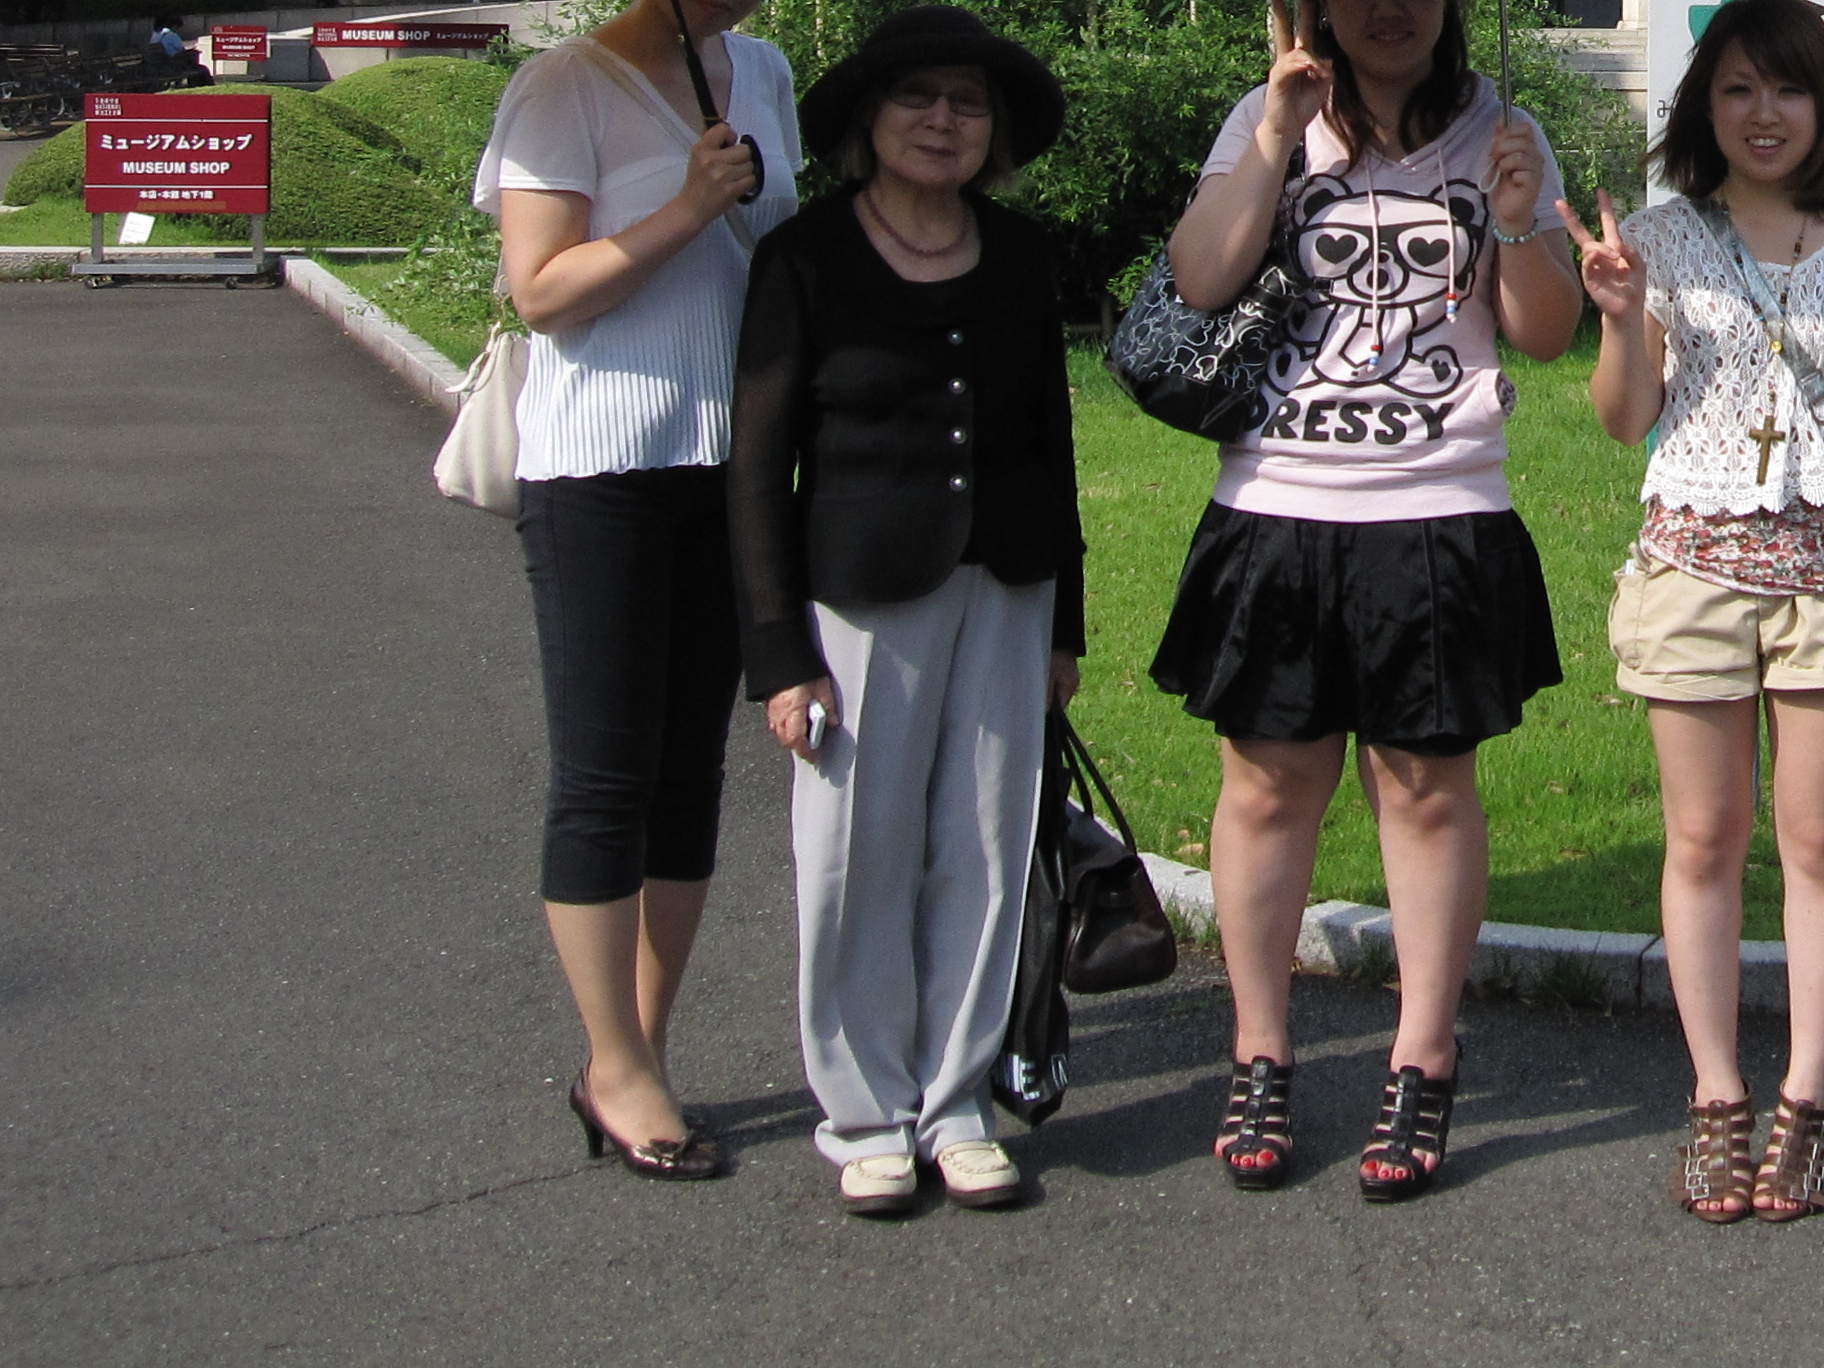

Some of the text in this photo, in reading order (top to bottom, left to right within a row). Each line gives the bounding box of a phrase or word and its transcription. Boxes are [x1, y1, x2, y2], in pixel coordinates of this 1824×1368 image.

[341, 29, 394, 41] MUSEUM
[397, 30, 431, 41] SHOP
[100, 133, 253, 151] ミュージアムショップ
[122, 161, 231, 174] MUSEUM SHOP
